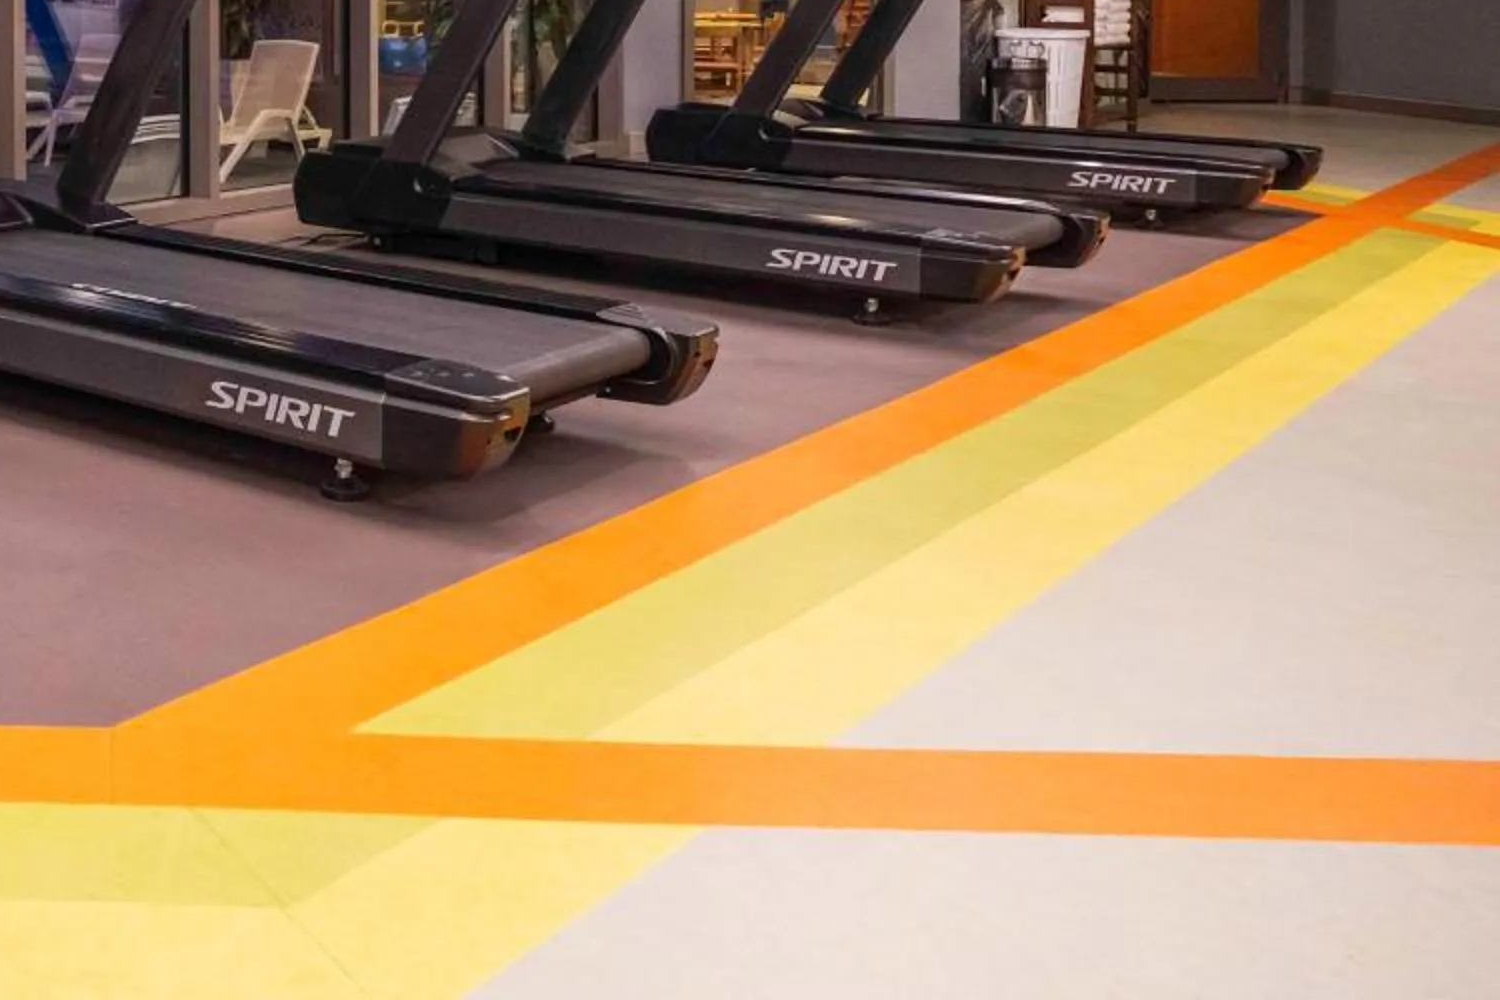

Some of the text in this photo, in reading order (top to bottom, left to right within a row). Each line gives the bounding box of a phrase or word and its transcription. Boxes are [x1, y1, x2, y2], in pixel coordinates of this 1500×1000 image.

[1066, 171, 1177, 194] SPIRIT
[765, 248, 898, 281] SPIRIT
[204, 380, 357, 438] SPIRIT
